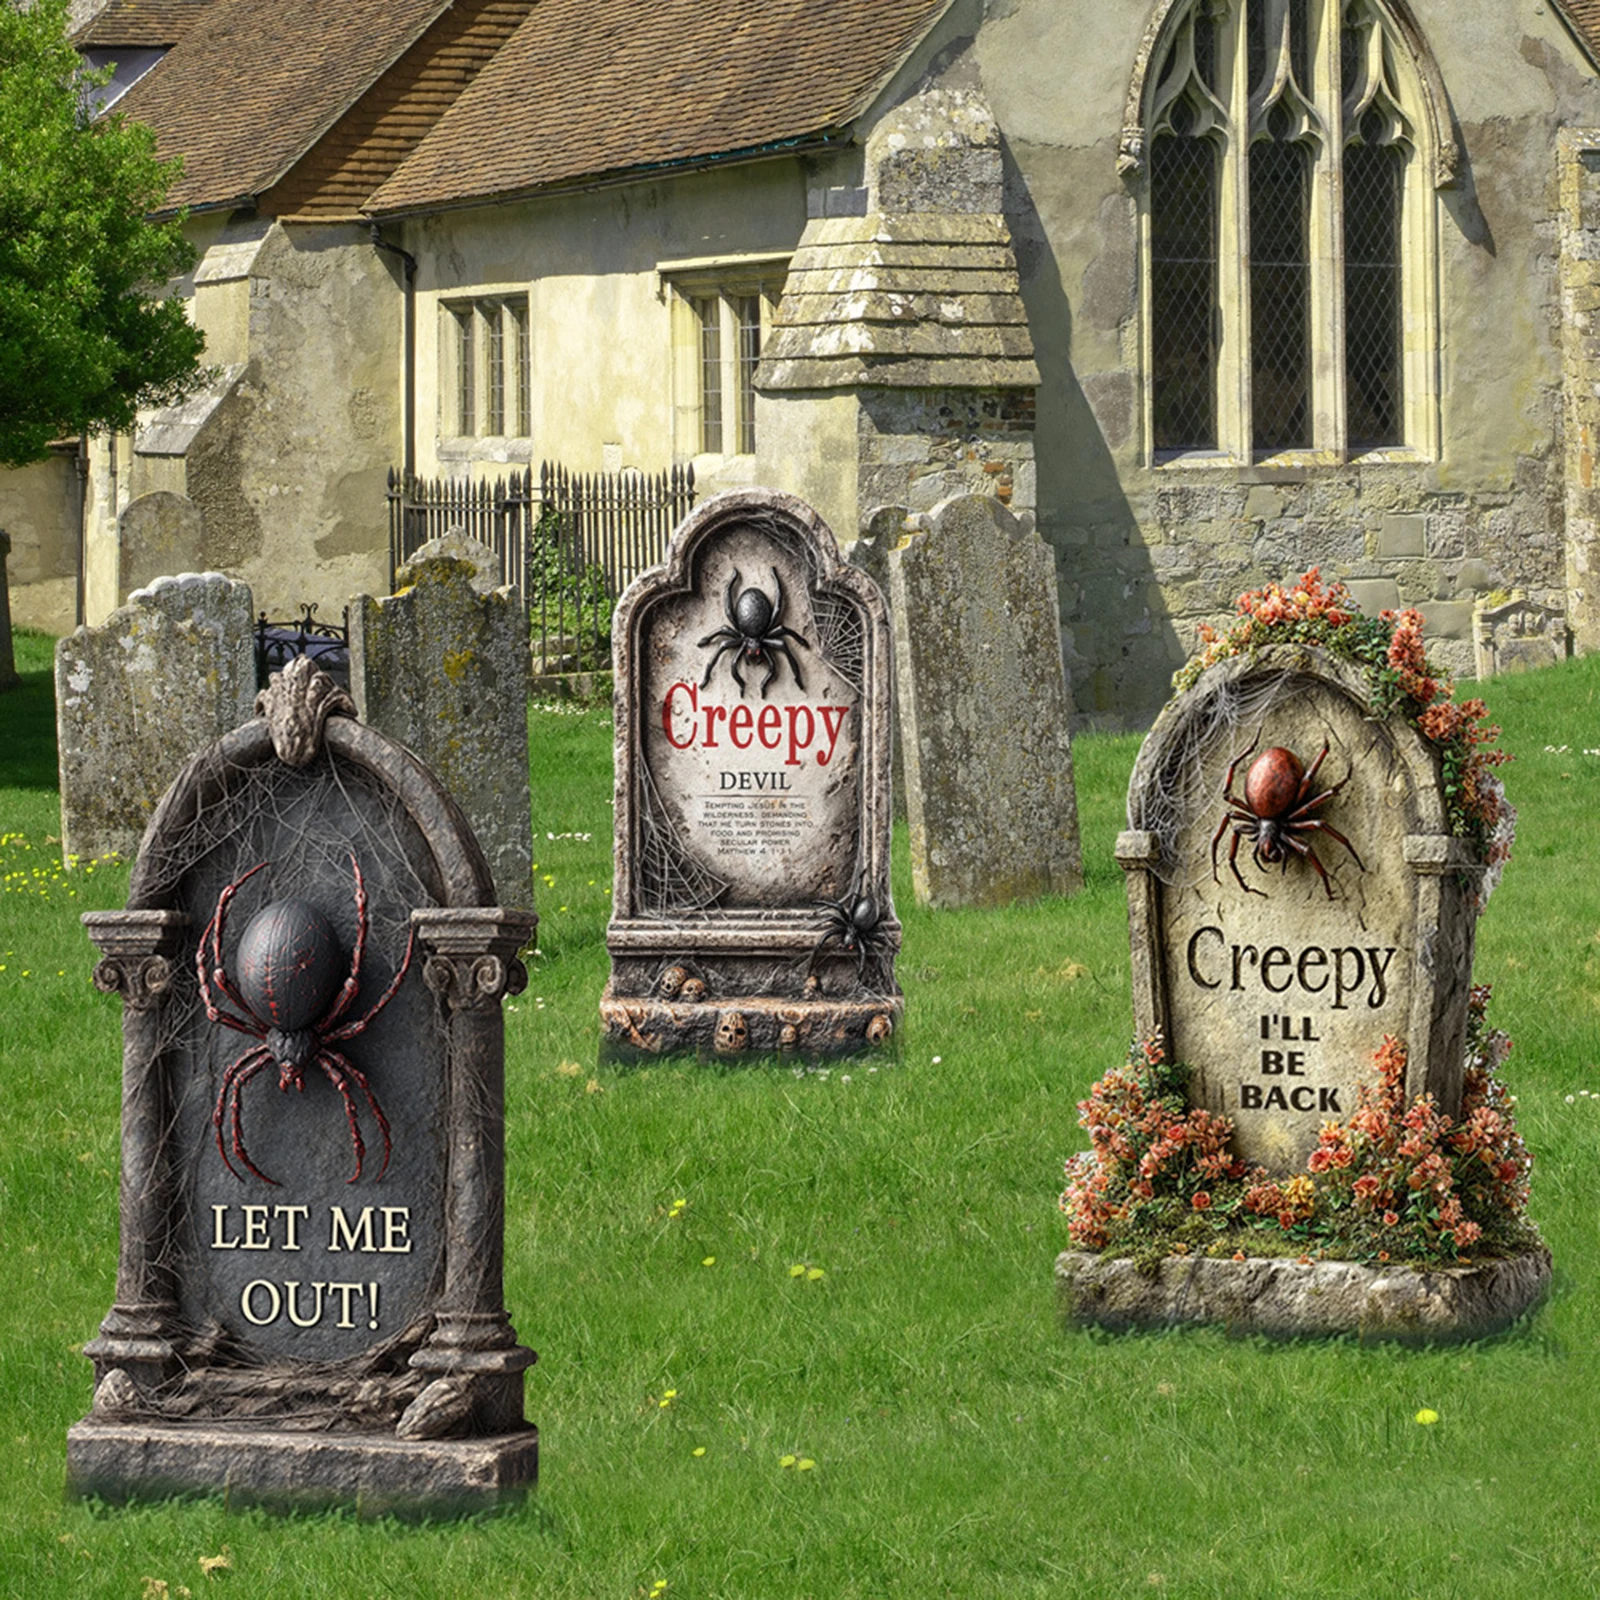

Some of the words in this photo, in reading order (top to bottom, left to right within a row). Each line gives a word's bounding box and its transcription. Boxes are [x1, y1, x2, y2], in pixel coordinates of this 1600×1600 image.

[661, 682, 850, 767] Creepy
[719, 771, 792, 790] DEVIL
[1187, 925, 1397, 1010] Creepy
[1260, 1014, 1320, 1041] I'LL
[1261, 1050, 1305, 1076] BE
[1241, 1085, 1342, 1113] BACK
[210, 1204, 309, 1251] LET
[327, 1206, 412, 1253] ME
[241, 1279, 379, 1330] OUT!
